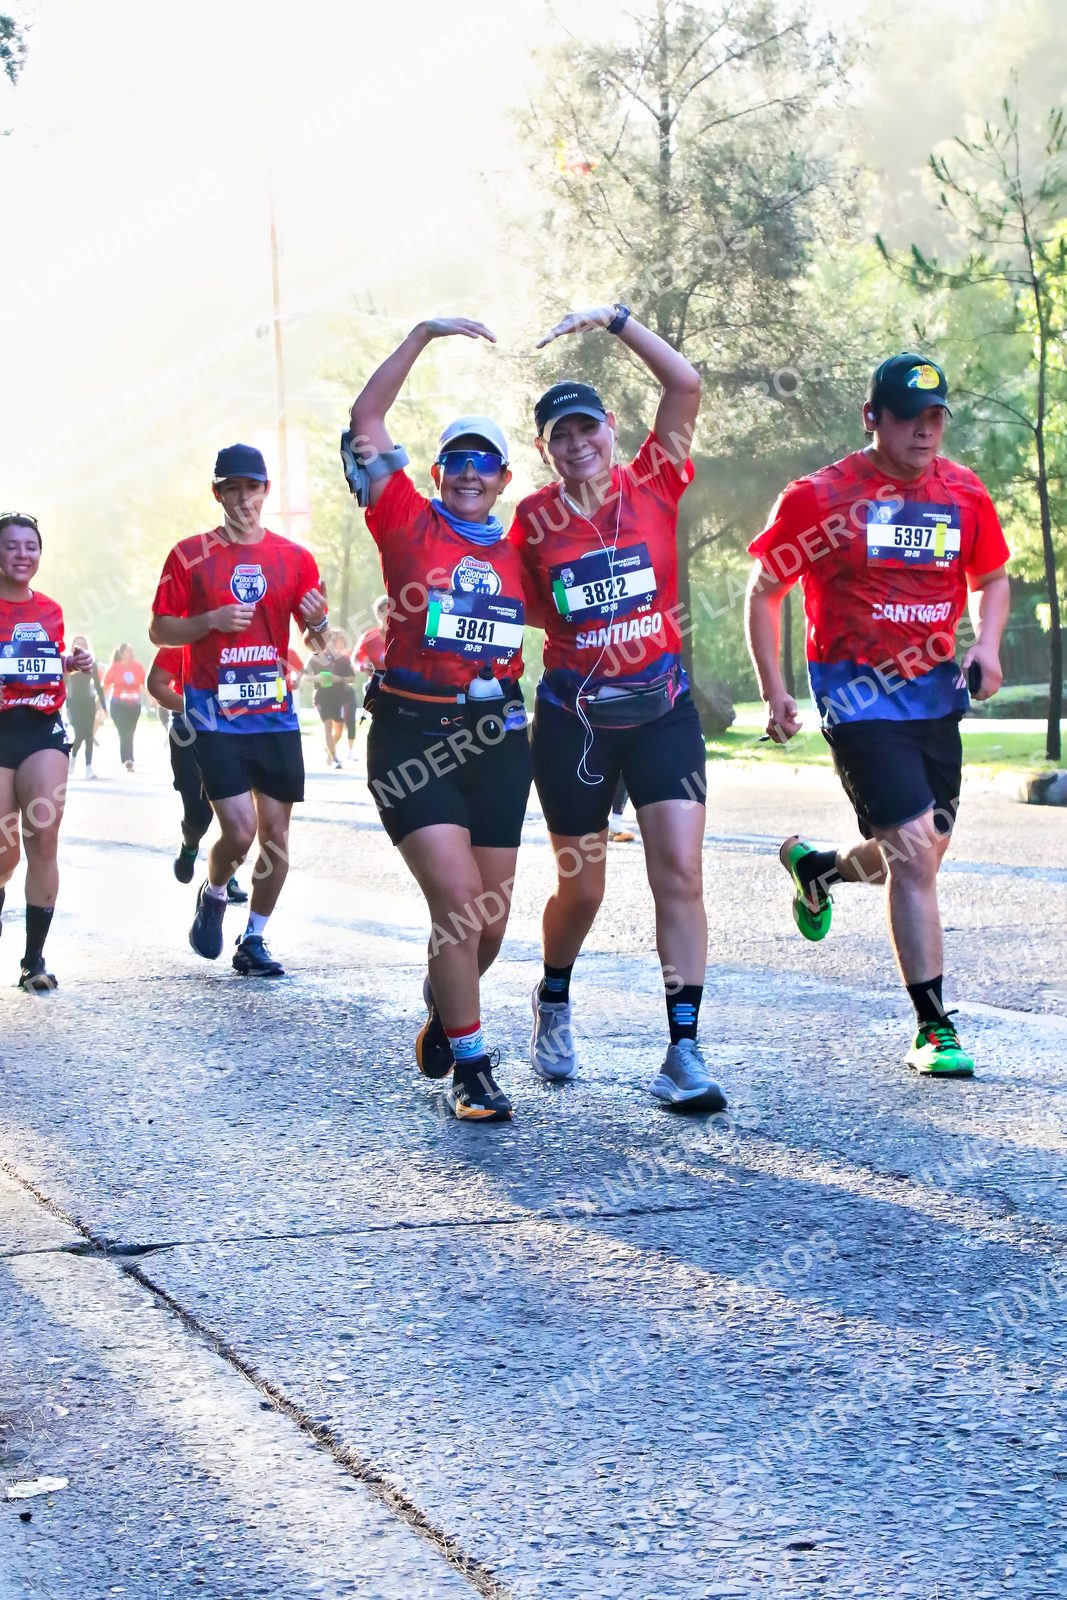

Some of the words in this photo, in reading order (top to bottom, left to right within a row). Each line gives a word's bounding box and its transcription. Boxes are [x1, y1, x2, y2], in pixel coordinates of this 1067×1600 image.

[552, 392, 579, 405] KIPRUN
[894, 526, 932, 548] 5397
[936, 560, 950, 568] 10K
[460, 575, 480, 584] Race
[465, 568, 488, 580] Global
[582, 576, 628, 606] 3822
[637, 604, 652, 613] 10K
[456, 618, 496, 643] 3841
[576, 612, 662, 650] SANTIAGO
[18, 658, 46, 673] 5467
[240, 684, 267, 698] 5641
